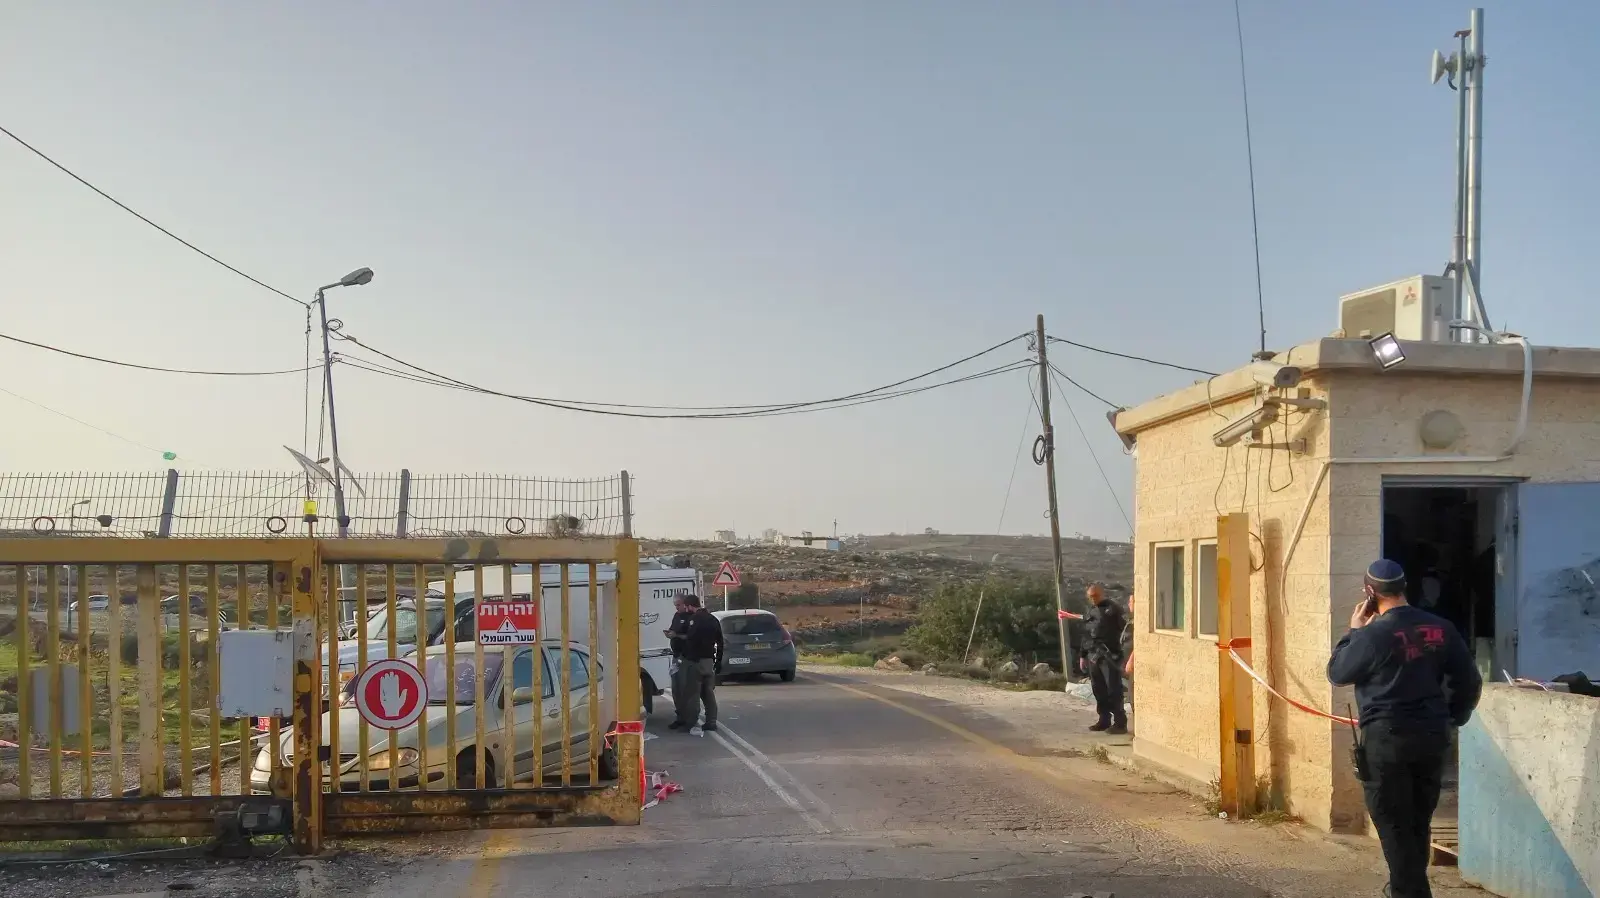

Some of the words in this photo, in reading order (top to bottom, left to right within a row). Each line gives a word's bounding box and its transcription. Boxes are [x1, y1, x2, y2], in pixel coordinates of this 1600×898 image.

[479, 603, 535, 616] זהירות
[481, 633, 512, 643] חשמלי
[514, 634, 535, 642] שער
